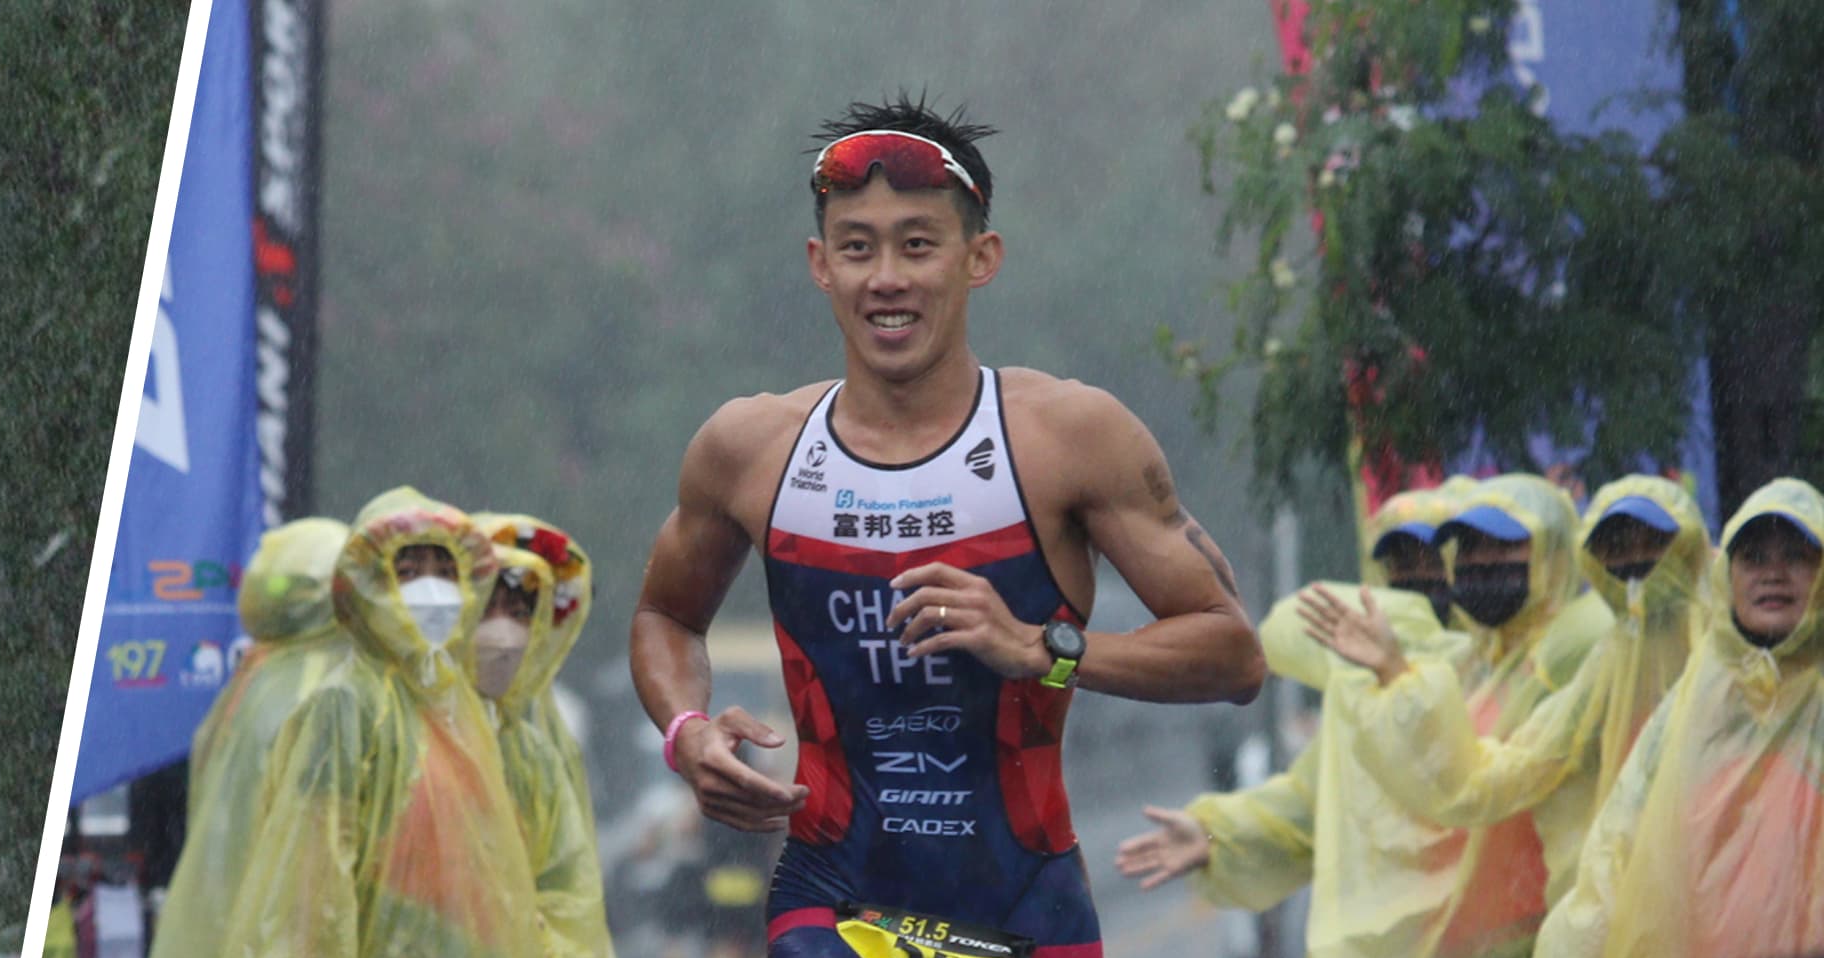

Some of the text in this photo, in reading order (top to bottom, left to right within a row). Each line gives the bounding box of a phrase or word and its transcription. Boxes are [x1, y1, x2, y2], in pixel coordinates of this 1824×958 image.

[798, 469, 825, 482] World
[857, 493, 954, 511] Fubon Financial
[833, 510, 956, 539] 富邦金控
[107, 640, 166, 681] 197
[859, 640, 953, 685] TPE
[865, 712, 962, 736] SAEKO
[872, 751, 969, 774] ZIV
[878, 788, 975, 806] GIANT
[882, 816, 977, 837] CADEX
[898, 915, 951, 941] 51.5
